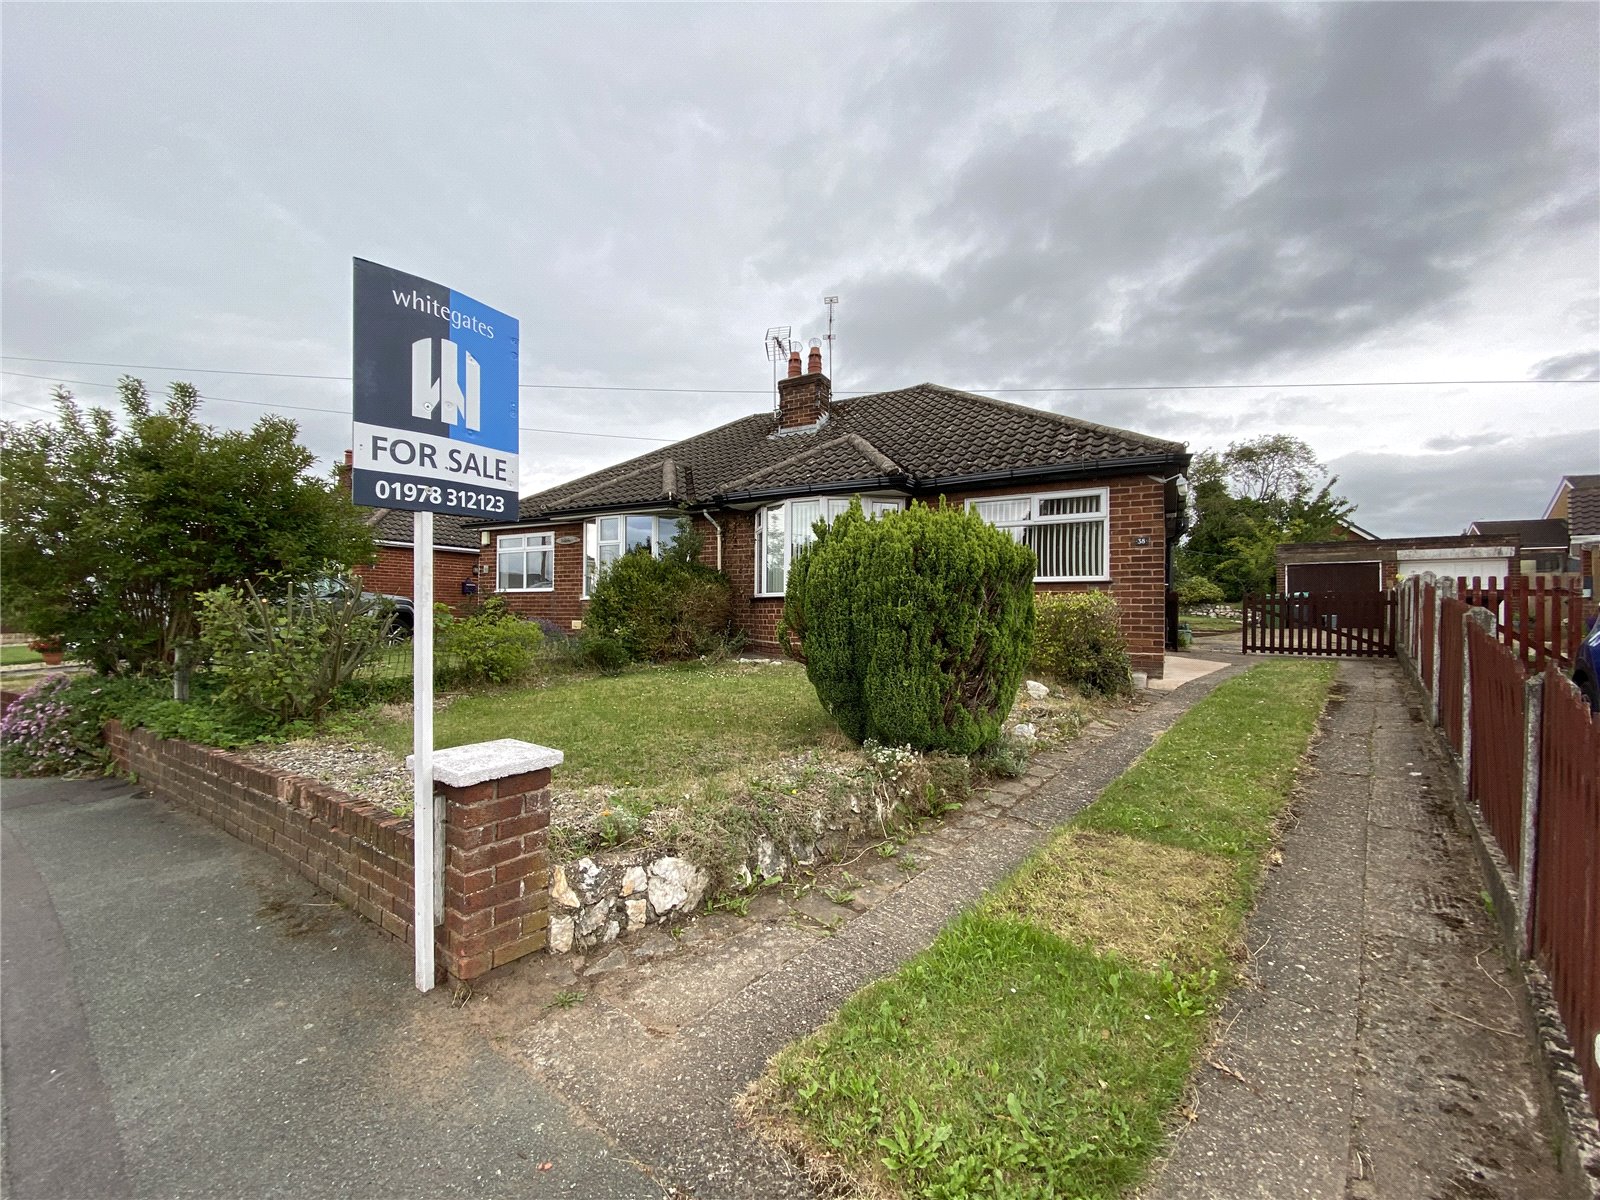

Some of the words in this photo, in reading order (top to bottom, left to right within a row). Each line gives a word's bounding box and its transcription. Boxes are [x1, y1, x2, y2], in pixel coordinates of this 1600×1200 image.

[392, 289, 494, 339] whitegates
[371, 435, 438, 469] FOR
[448, 449, 507, 482] SALE
[375, 480, 442, 504] 01978
[446, 488, 505, 513] 312123
